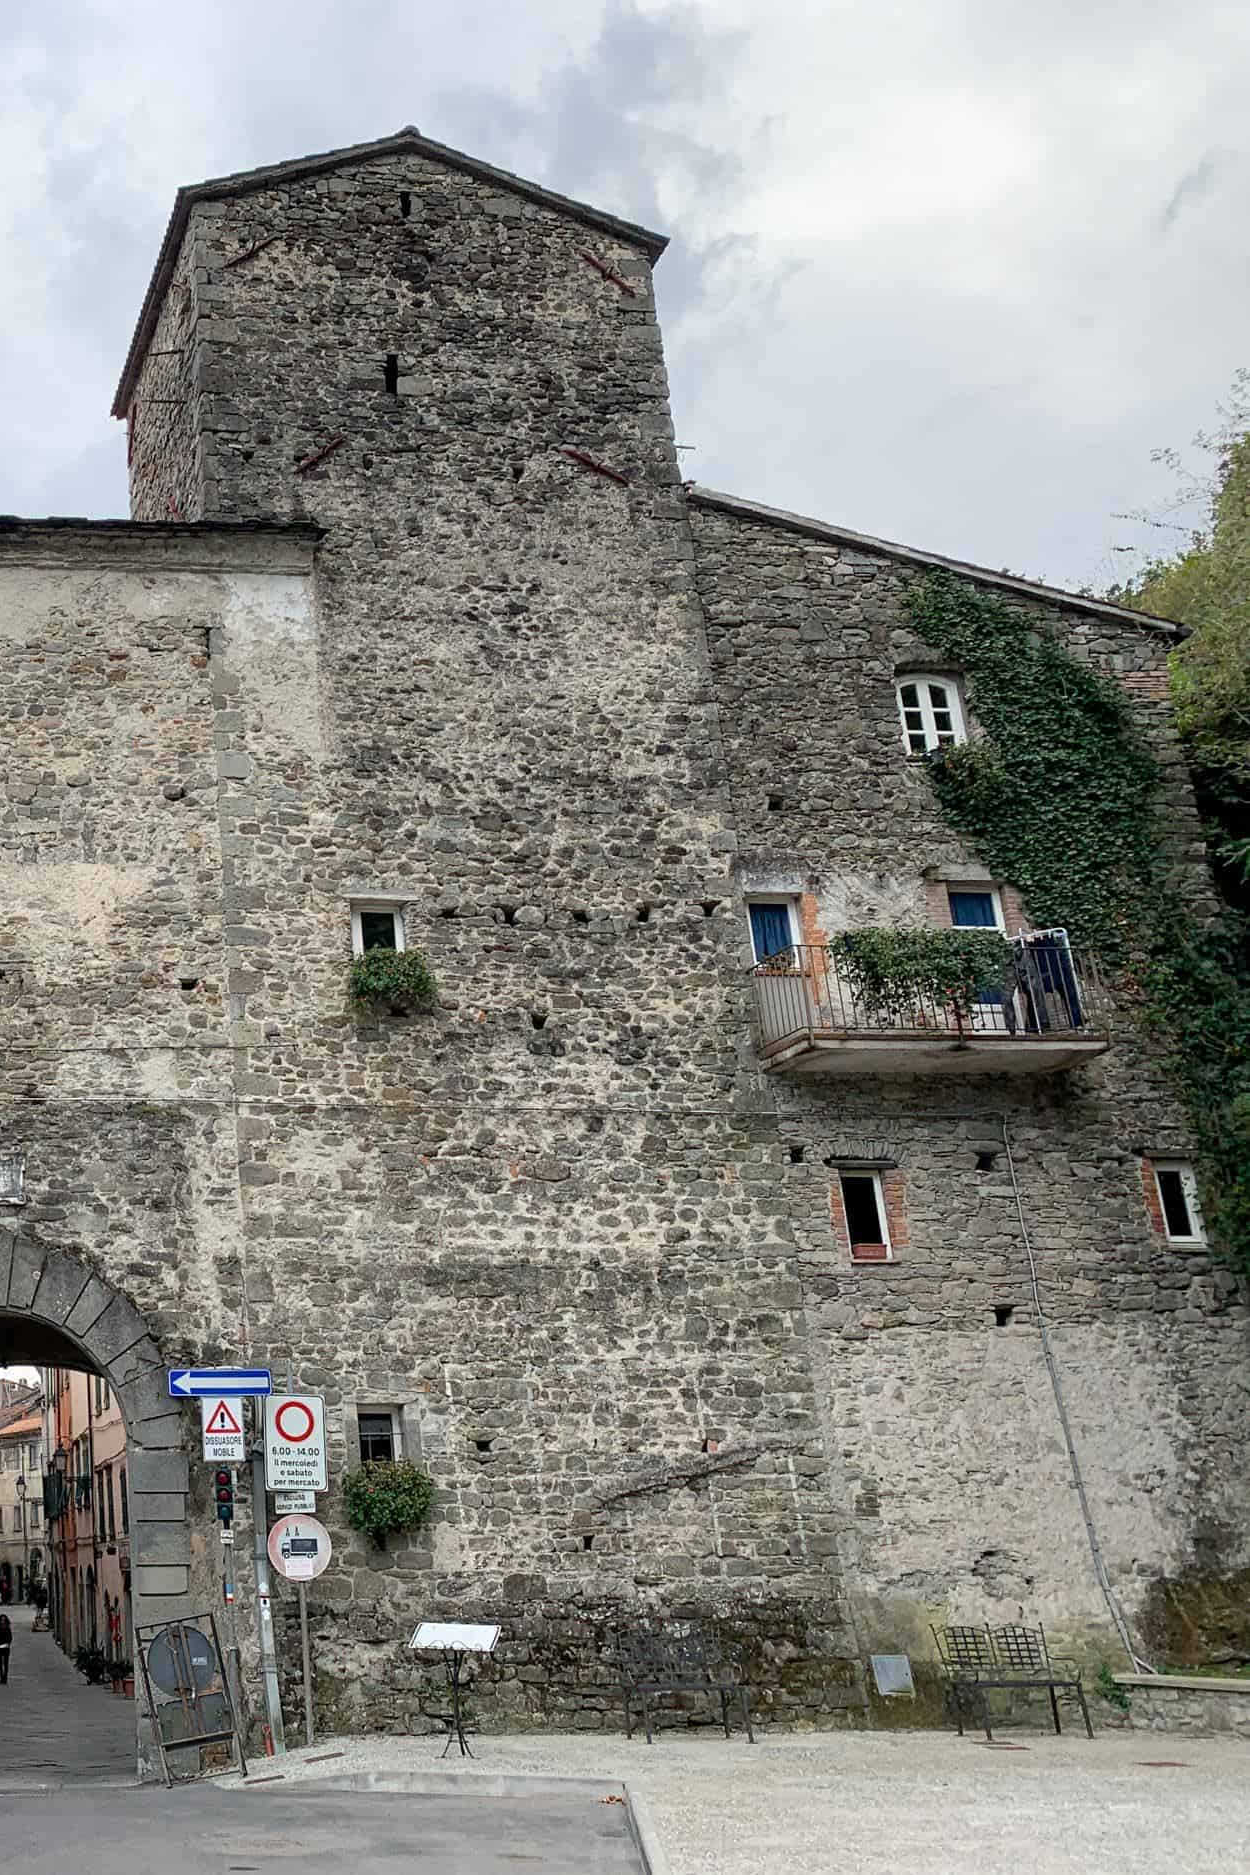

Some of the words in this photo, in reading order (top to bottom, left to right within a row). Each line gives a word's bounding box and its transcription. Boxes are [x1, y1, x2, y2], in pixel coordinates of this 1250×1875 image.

[205, 1436, 242, 1445] DISSUASORE
[213, 1447, 235, 1456] MOBILE
[288, 1478, 320, 1486] mercato
